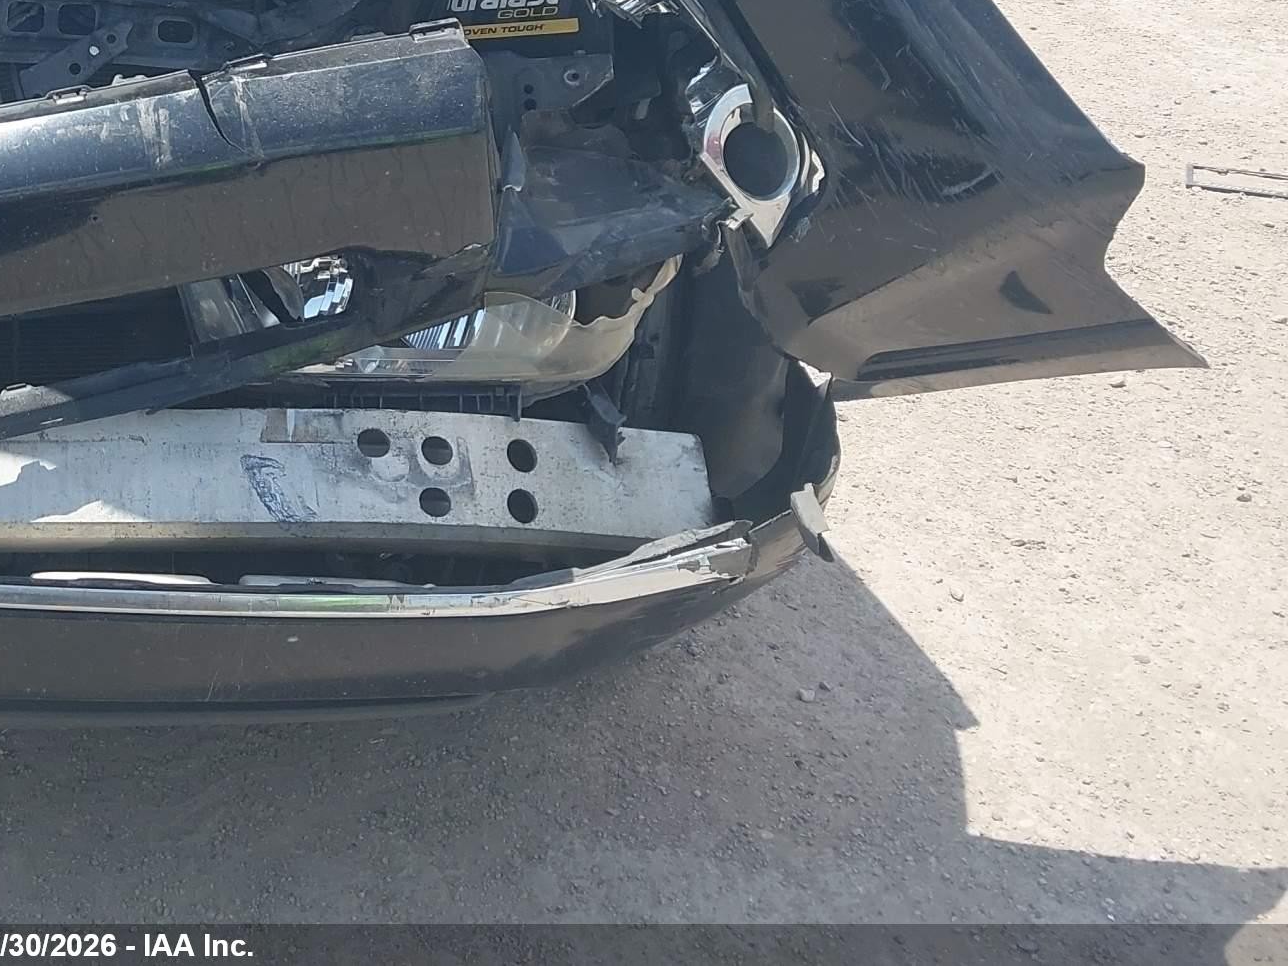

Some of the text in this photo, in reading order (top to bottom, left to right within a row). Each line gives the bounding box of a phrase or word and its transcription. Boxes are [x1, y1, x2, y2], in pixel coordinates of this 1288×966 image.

[497, 7, 558, 19] GOLD
[464, 24, 544, 36] OVEN TOUGH
